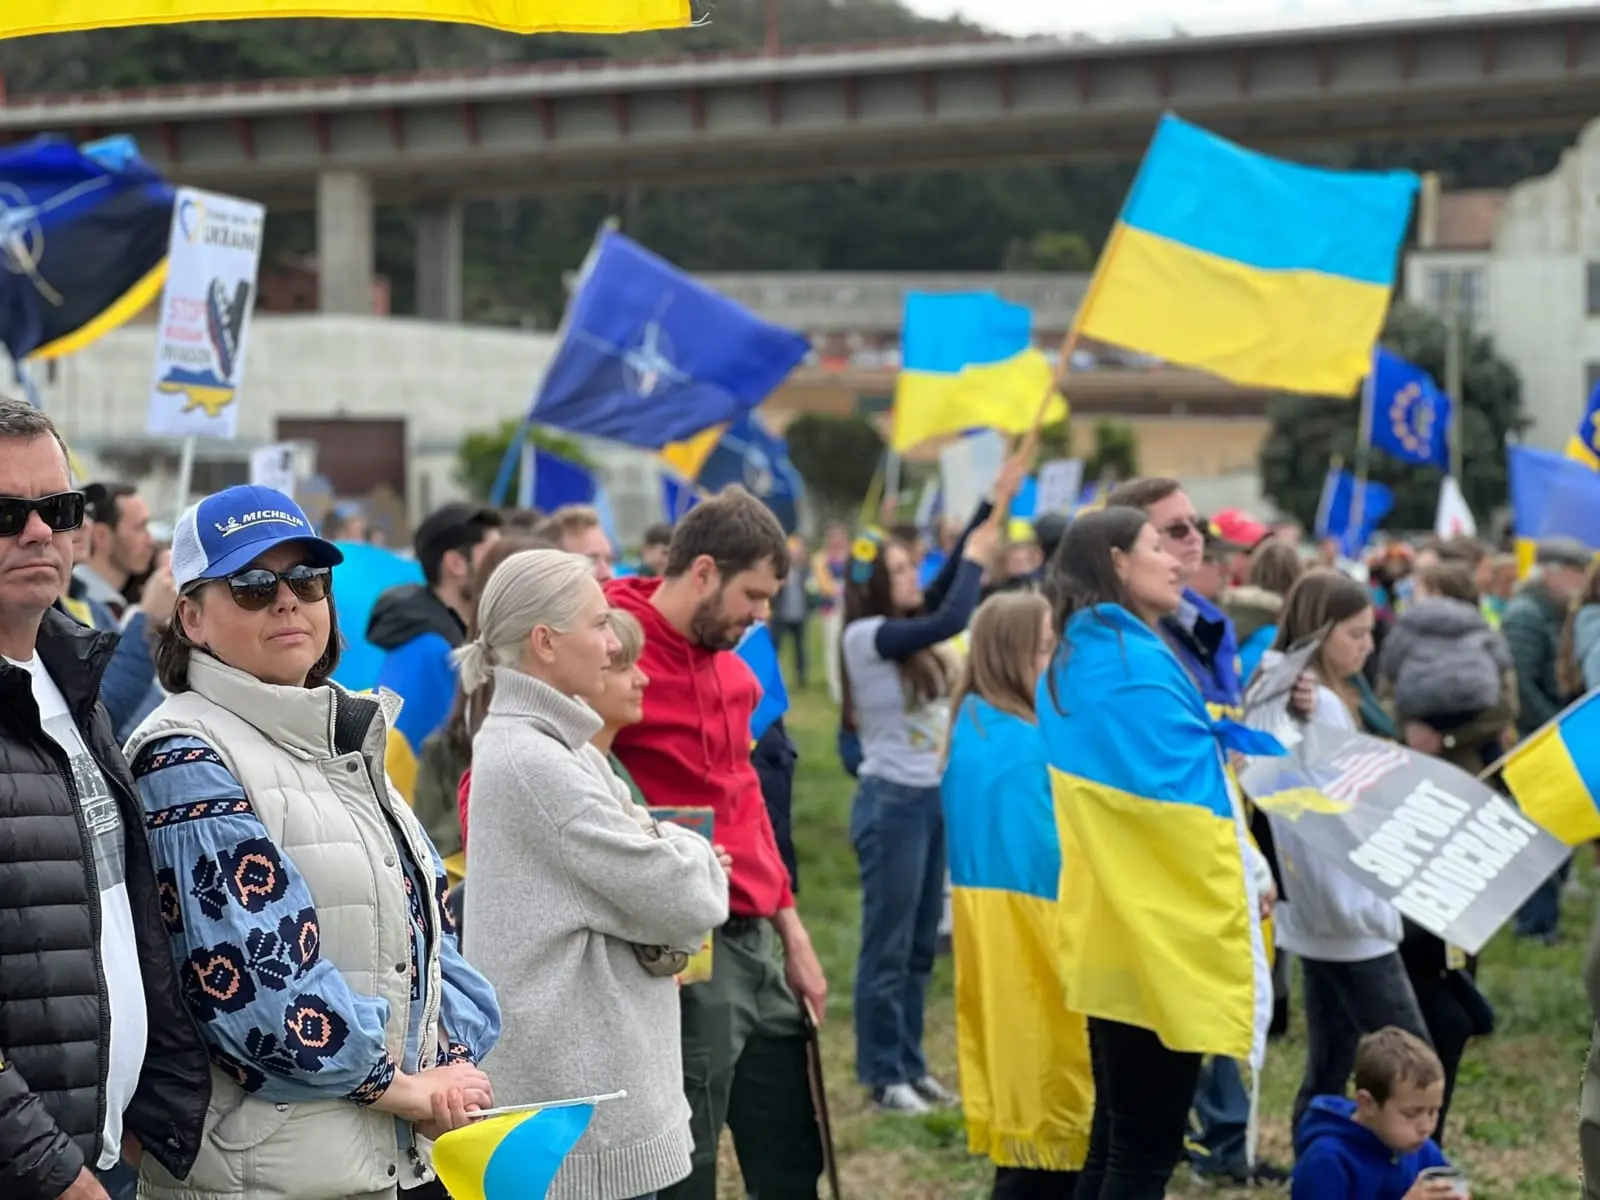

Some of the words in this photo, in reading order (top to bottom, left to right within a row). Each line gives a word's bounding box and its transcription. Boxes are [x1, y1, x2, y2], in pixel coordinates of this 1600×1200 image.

[242, 510, 303, 527] MICHELIN
[1348, 778, 1472, 888] SUPPORT
[1390, 794, 1539, 932] DEMOCRACY
